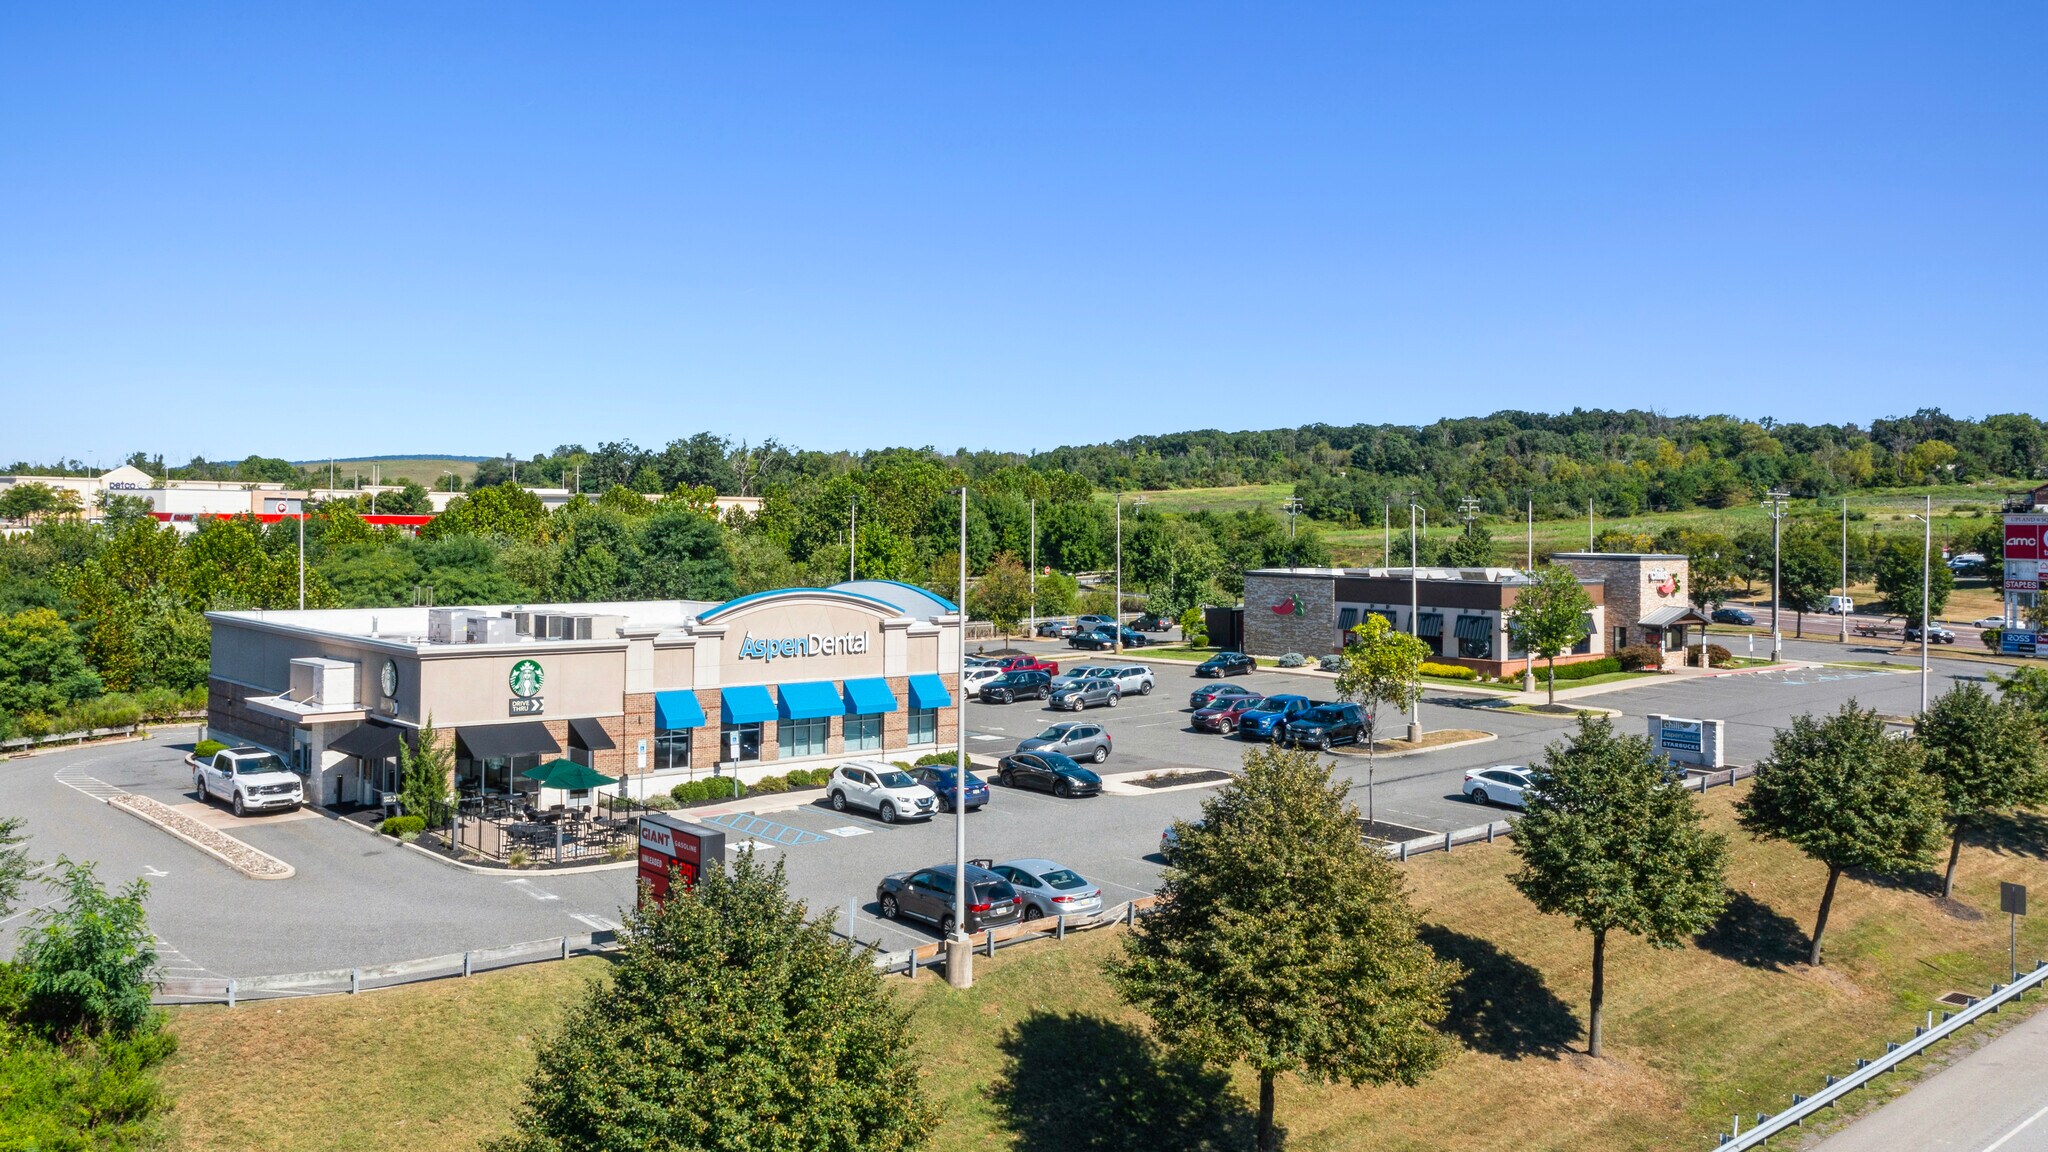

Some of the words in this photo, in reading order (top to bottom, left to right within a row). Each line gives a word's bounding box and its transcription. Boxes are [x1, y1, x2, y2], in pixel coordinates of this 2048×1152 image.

[109, 481, 136, 490] petco
[2005, 580, 2037, 589] STAPLES
[2007, 634, 2030, 642] ROSS
[511, 699, 530, 707] DRIVE
[1662, 741, 1699, 750] STARBUCKS
[641, 827, 670, 847] GIANT
[674, 840, 697, 853] GASOLINE
[641, 854, 662, 868] UNLEADED
